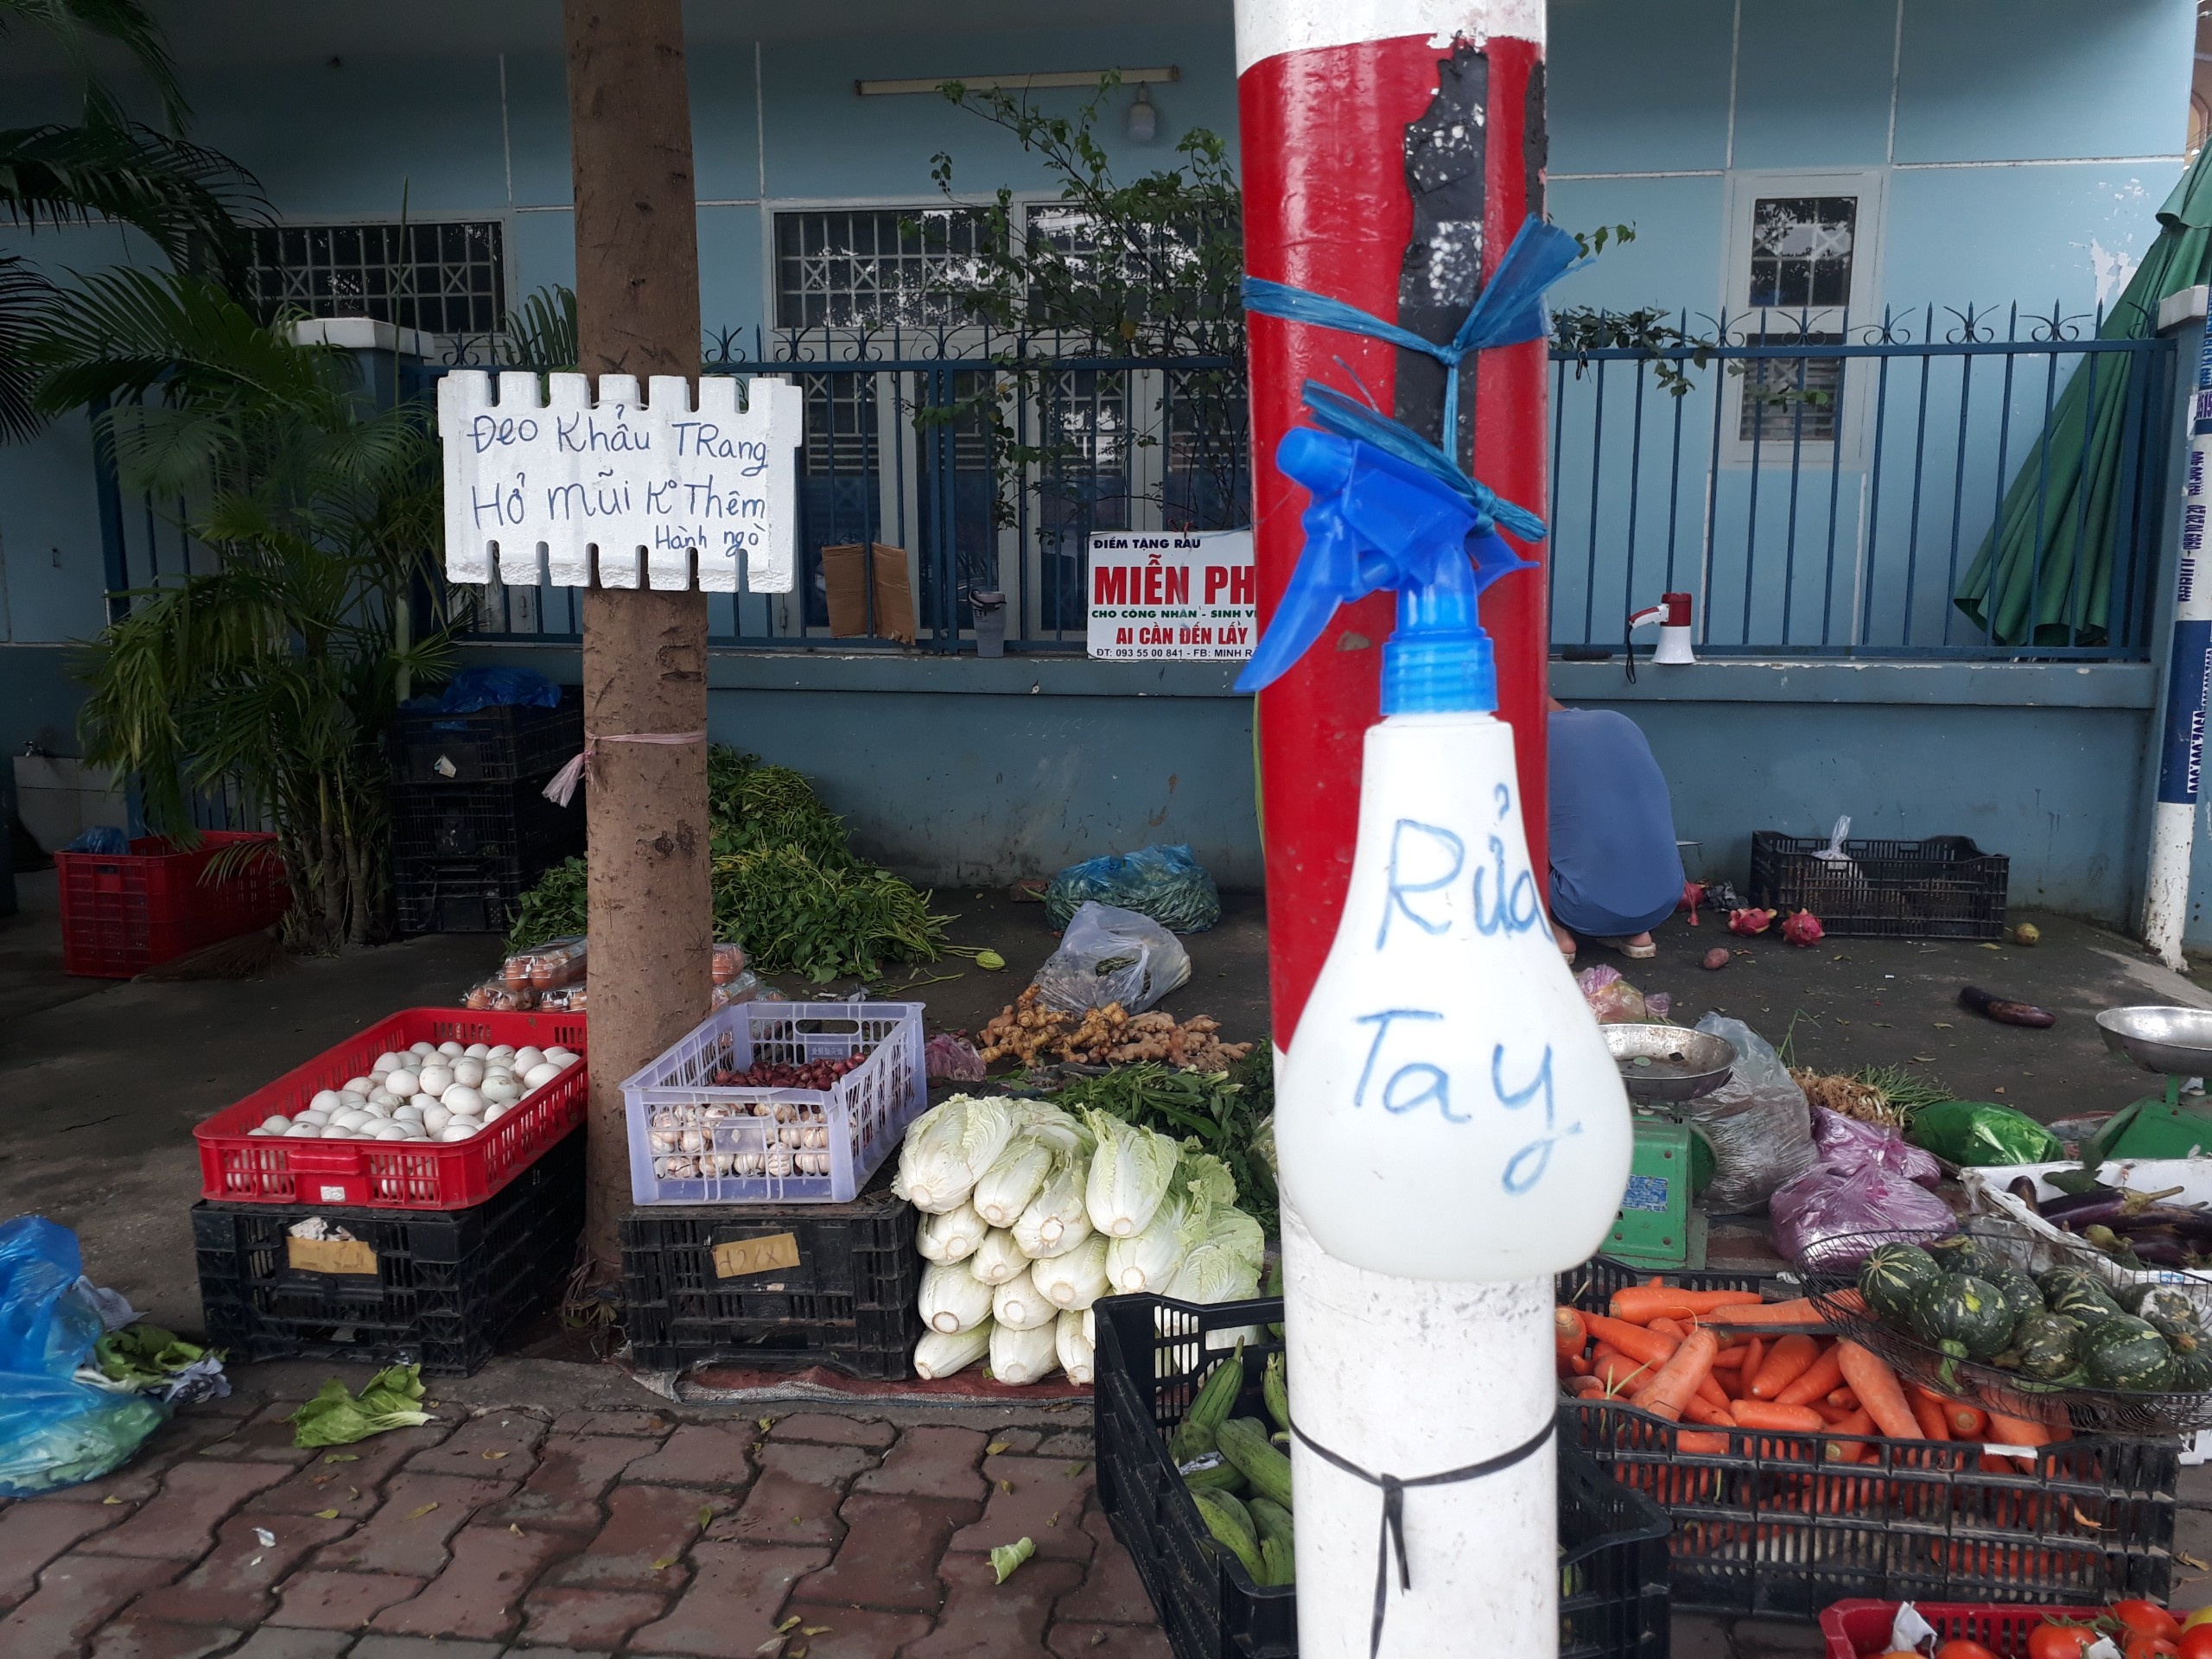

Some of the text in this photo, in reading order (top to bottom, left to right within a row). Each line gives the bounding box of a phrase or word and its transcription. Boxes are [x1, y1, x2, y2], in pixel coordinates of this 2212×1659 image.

[655, 525, 707, 550] Hành
[1174, 538, 1201, 549] RAU
[1094, 554, 1255, 605] MIỄN PH
[1091, 610, 1117, 619] CHO
[1121, 608, 1157, 619] CÔNG
[1161, 608, 1198, 619] NHÂN
[1211, 610, 1241, 619] SINH
[1116, 622, 1249, 645] AI CẦN ĐẾN LẤY
[1096, 649, 1112, 658] ĐT:
[1116, 649, 1134, 658] 093
[1136, 649, 1148, 658] 55
[1151, 649, 1163, 658] 00
[1166, 649, 1183, 658] 841
[1193, 649, 1211, 658] FB:
[1214, 649, 1242, 658] MINH
